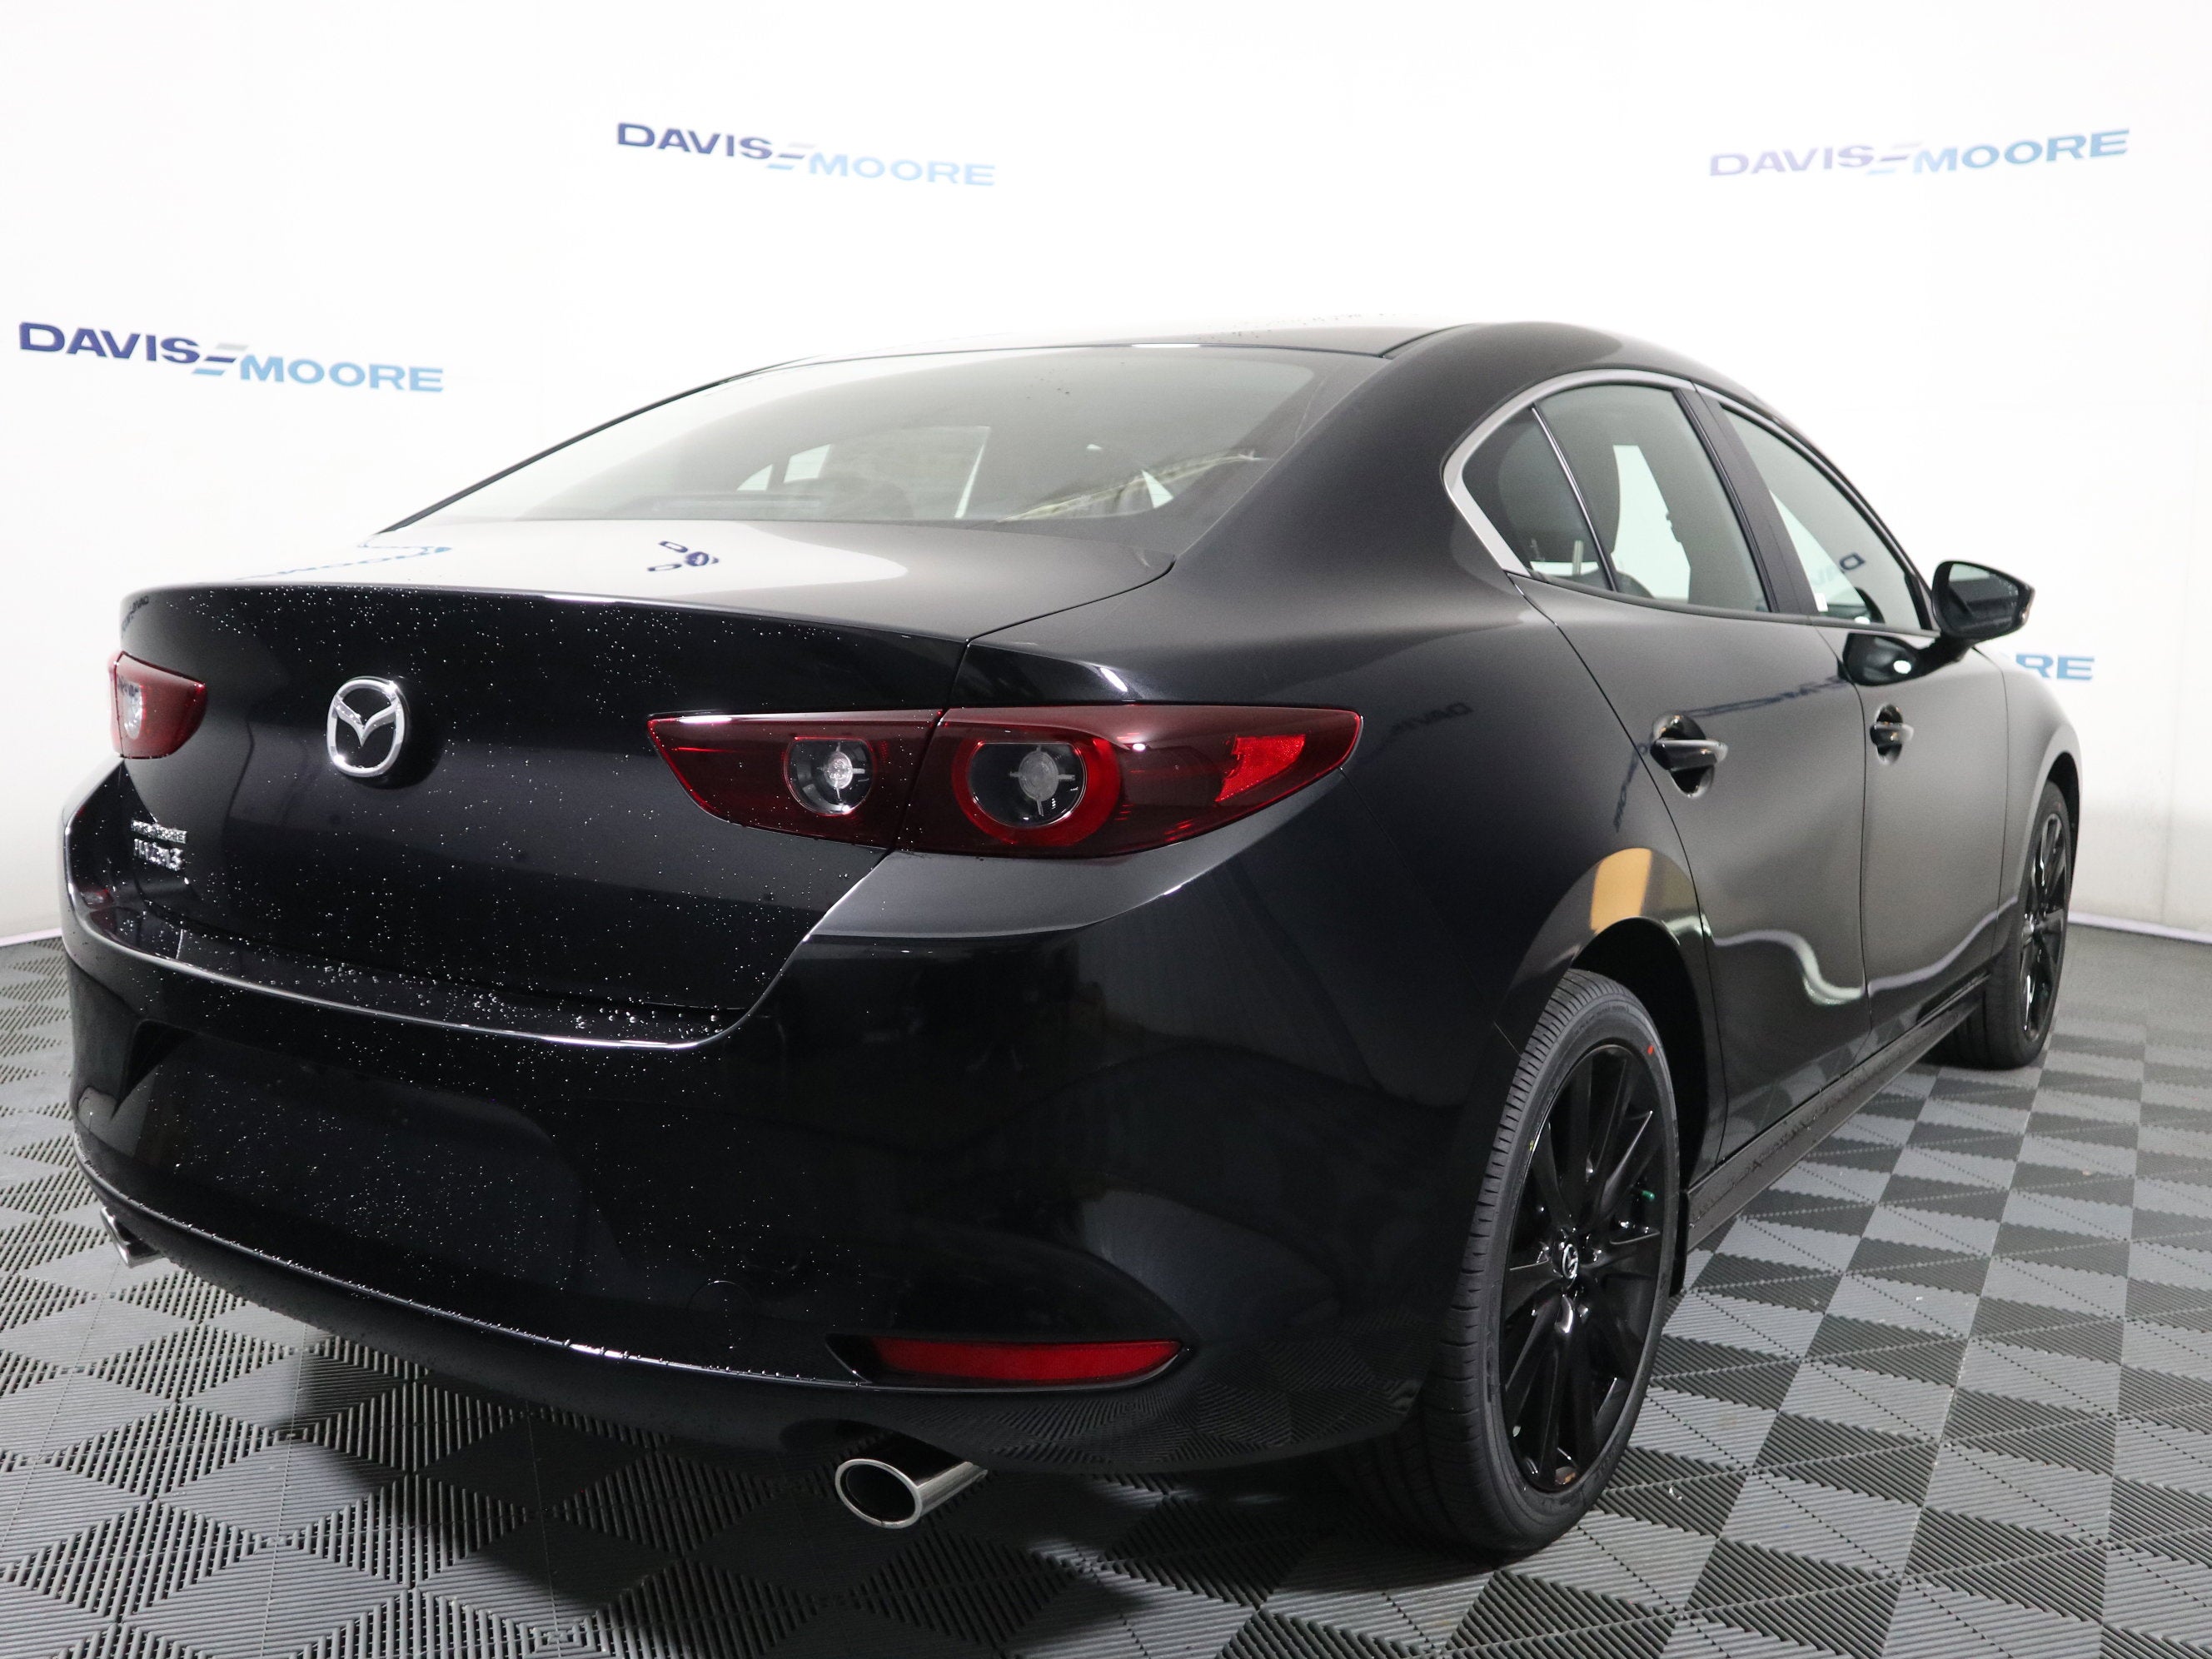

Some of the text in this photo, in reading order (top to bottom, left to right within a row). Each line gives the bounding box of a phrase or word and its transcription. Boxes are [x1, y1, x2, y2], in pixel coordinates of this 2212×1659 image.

[617, 122, 996, 187] DAVIS MOORE
[1709, 128, 2130, 177] DAVIS MOORE
[18, 321, 445, 393] DAVIS MOORE
[2015, 653, 2094, 681] RE
